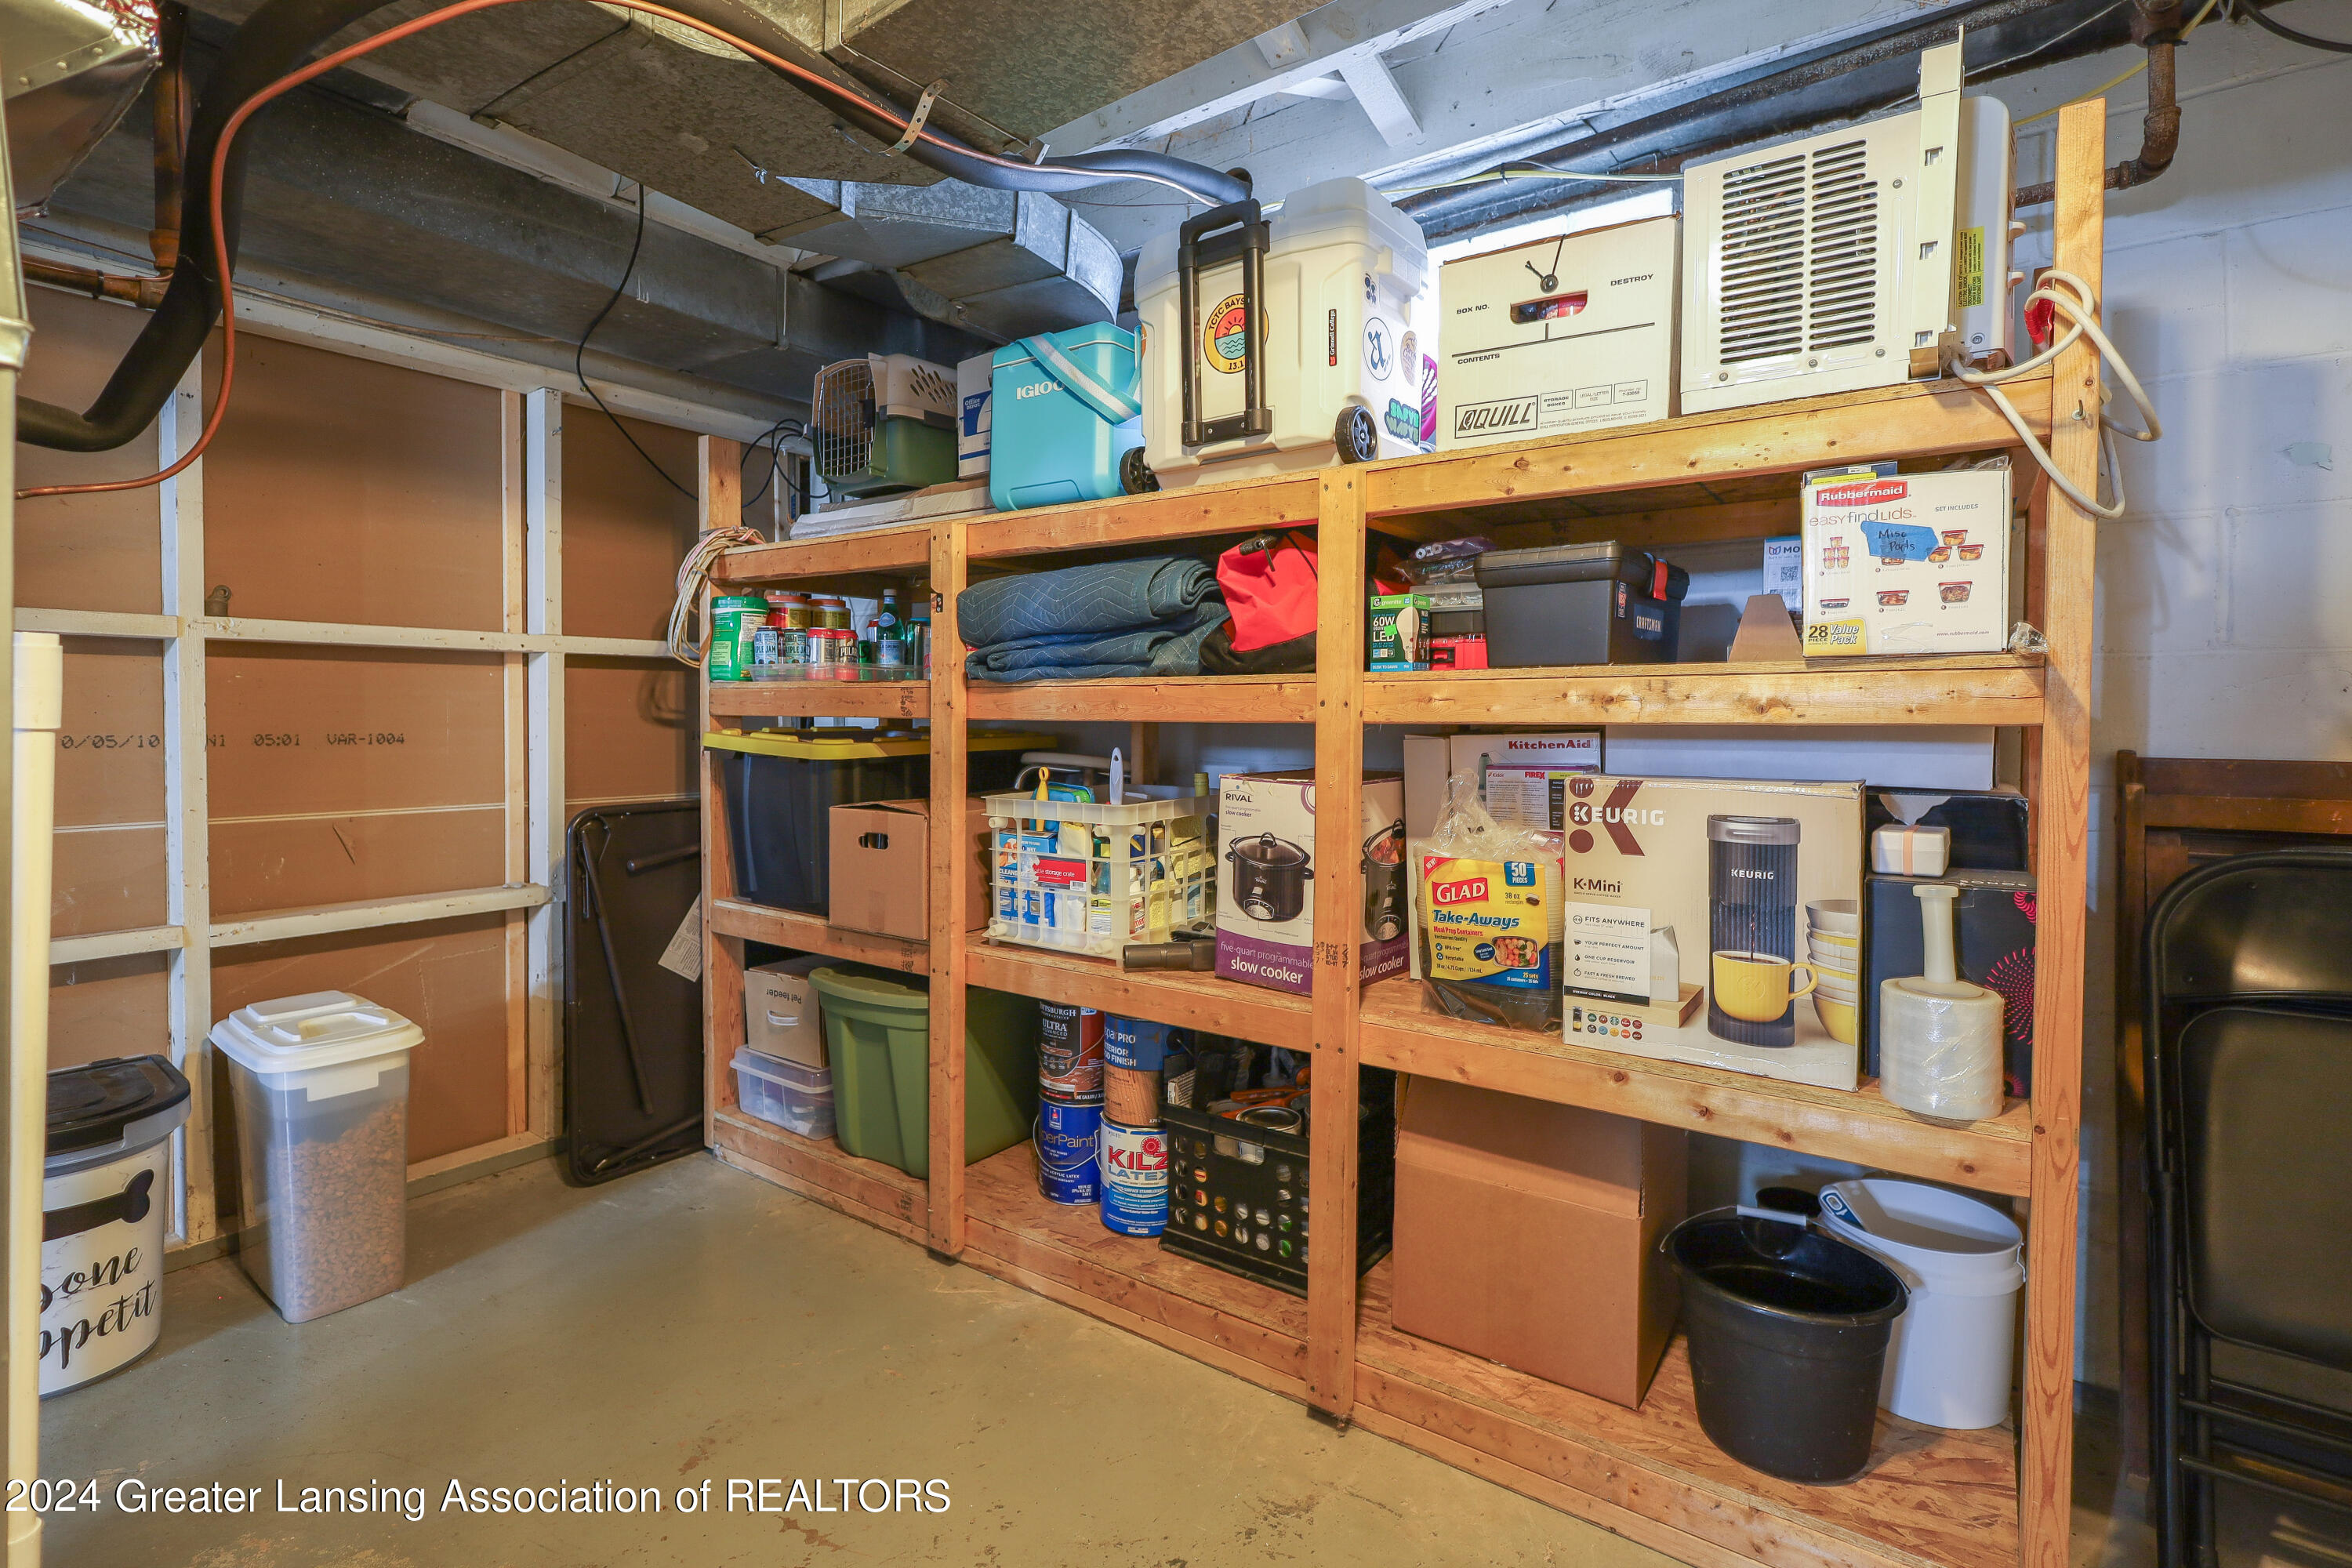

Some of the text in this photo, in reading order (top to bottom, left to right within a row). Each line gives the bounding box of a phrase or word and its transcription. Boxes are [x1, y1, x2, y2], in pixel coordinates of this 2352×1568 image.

[1610, 274, 1654, 286] DESTROY
[1209, 307, 1225, 330] TCTC
[1457, 353, 1501, 365] CONTENTS
[964, 397, 981, 406] Office
[1473, 402, 1532, 430] QUILL
[1821, 485, 1904, 502] Rubbermaid
[1878, 528, 1907, 539] Misc
[1889, 539, 1915, 551] Parts
[1373, 616, 1396, 626] 60W
[1636, 615, 1661, 633] CRAFTSMAN
[1808, 625, 1828, 638] 28
[1830, 624, 1860, 634] Value
[1830, 633, 1857, 645] Pack
[766, 645, 776, 654] JAM
[252, 733, 302, 747] 05:01
[326, 732, 406, 746] VAR-1004
[1508, 739, 1591, 750] KitchenAid
[1524, 771, 1545, 780] FIREX
[1225, 793, 1253, 803] RIVAL
[1573, 805, 1664, 826] KEURIG
[1425, 857, 1438, 870] NEW!
[1511, 862, 1527, 877] 50
[1730, 868, 1775, 880] KEURIG
[1436, 882, 1486, 903] GLAD
[1432, 909, 1520, 931] Take-Aways
[1602, 917, 1646, 928] ANYWHERE
[1445, 927, 1457, 935] Prep
[1457, 928, 1483, 937] Containers
[1221, 941, 1313, 969] five-quart programmable
[1230, 956, 1303, 984] slow cooker
[1359, 955, 1404, 981] slow cooker
[766, 989, 802, 1004] Pet feeder
[1042, 1018, 1068, 1032] ULTRA
[1042, 1027, 1068, 1037] ADVANCED
[1111, 1054, 1136, 1067] FINISH
[1108, 1145, 1168, 1171] KILZ
[1108, 1164, 1168, 1181] LATEX
